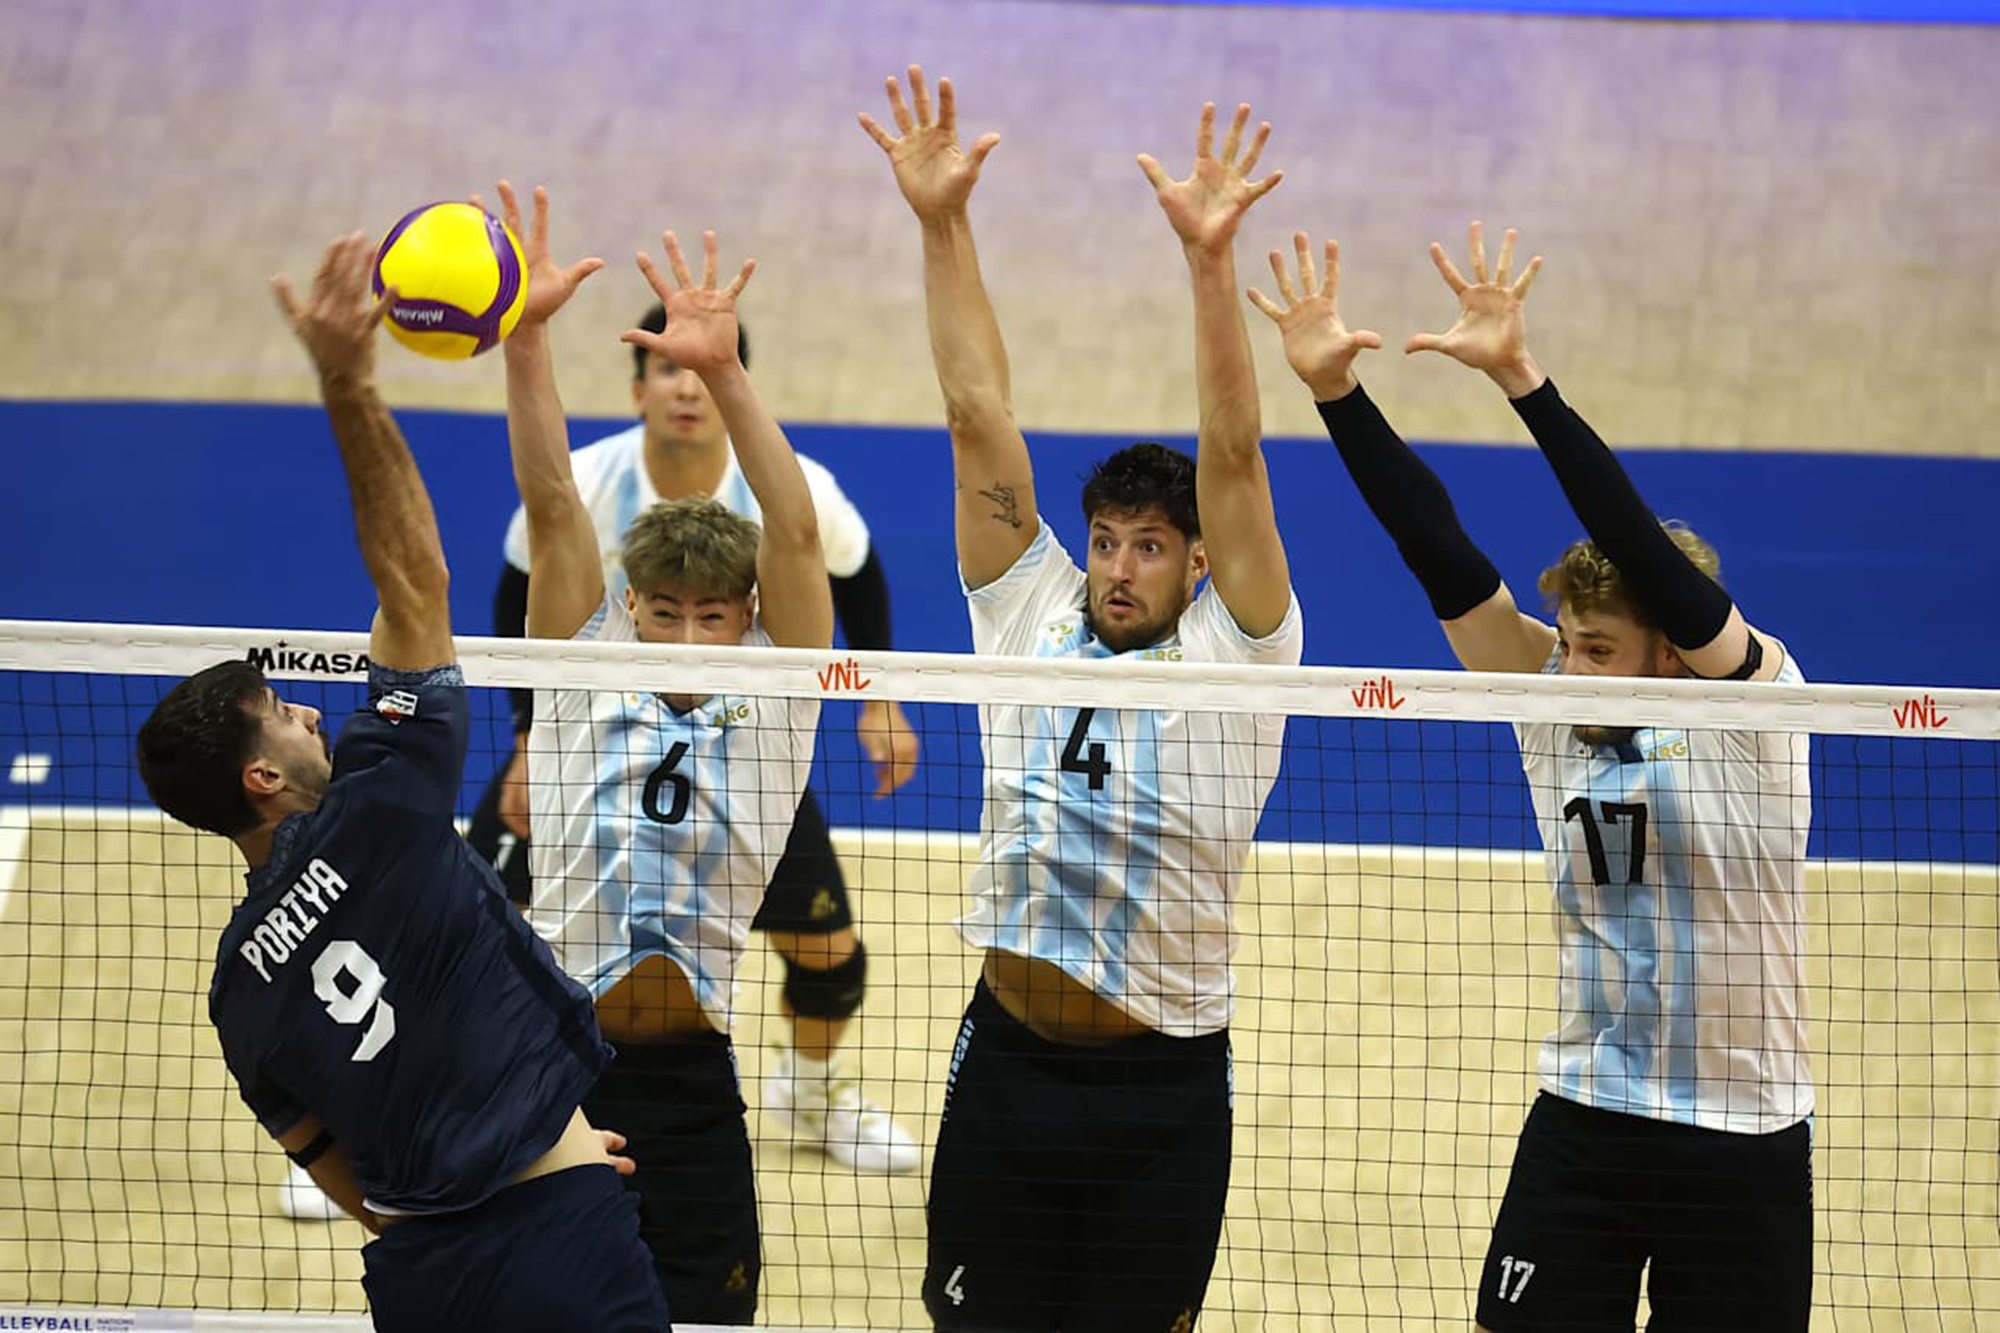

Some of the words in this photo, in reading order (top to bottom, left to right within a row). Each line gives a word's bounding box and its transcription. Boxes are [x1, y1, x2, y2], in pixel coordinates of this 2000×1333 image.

[817, 657, 871, 691] VNL
[1351, 675, 1405, 710] VNL
[1893, 694, 1948, 729] VNL
[1061, 708, 1112, 790] 4
[642, 741, 690, 825] 6
[1563, 797, 1647, 887] 17
[239, 858, 349, 983] PORIYA
[310, 940, 397, 1062] 9
[944, 1265, 966, 1306] 4
[1497, 1255, 1536, 1304] 17
